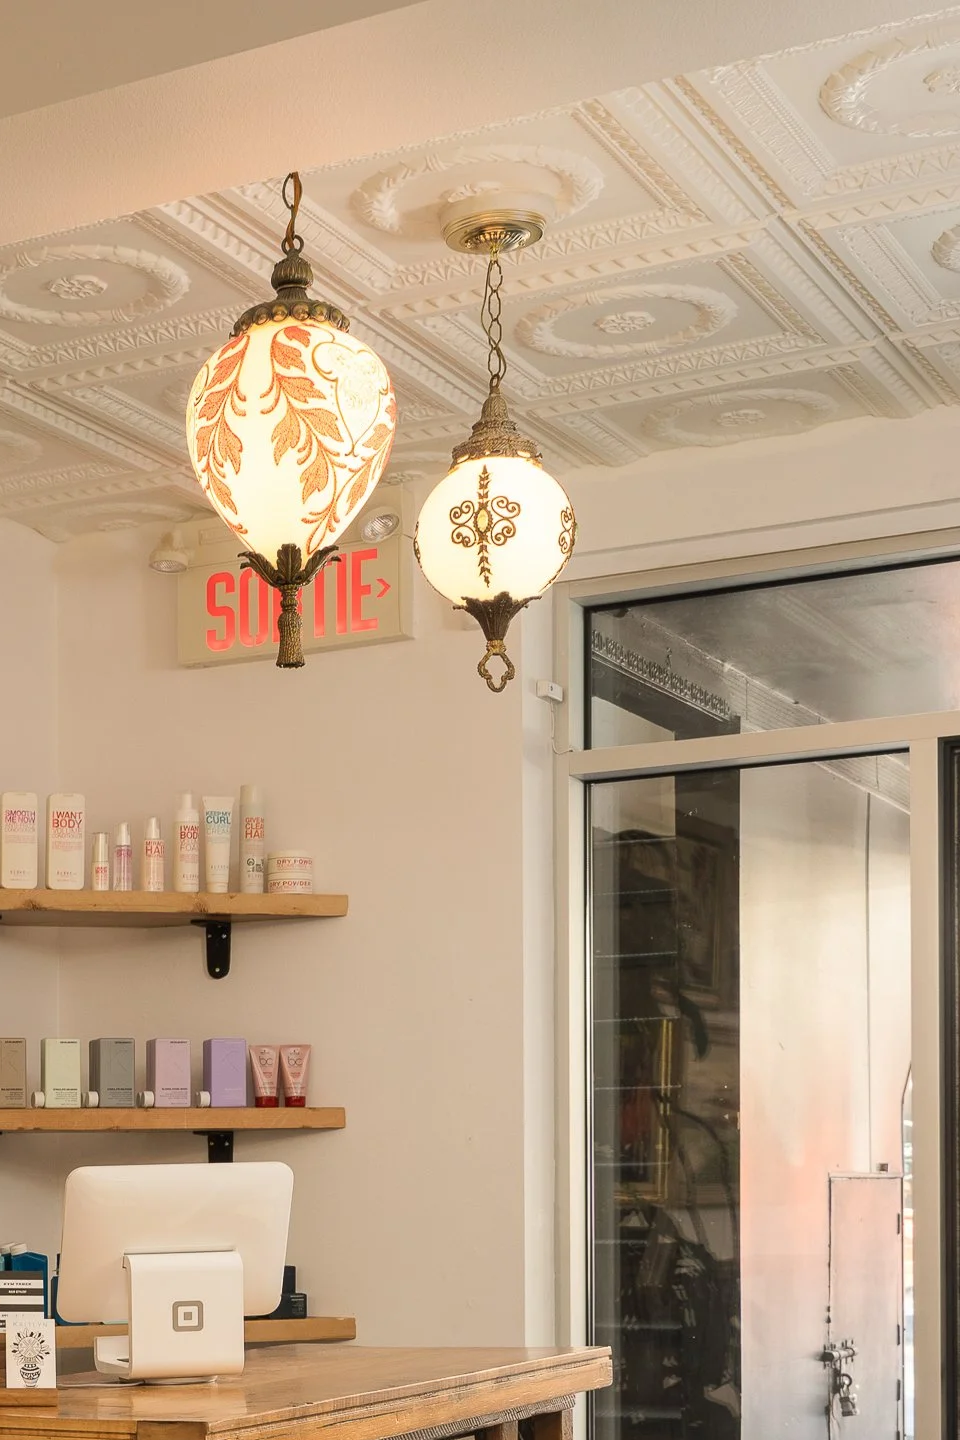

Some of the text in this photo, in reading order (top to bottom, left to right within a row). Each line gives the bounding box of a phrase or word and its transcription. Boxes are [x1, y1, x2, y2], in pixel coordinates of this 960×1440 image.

[56, 811, 82, 819] WANT
[52, 819, 82, 828] BODY
[206, 816, 231, 824] CURL
